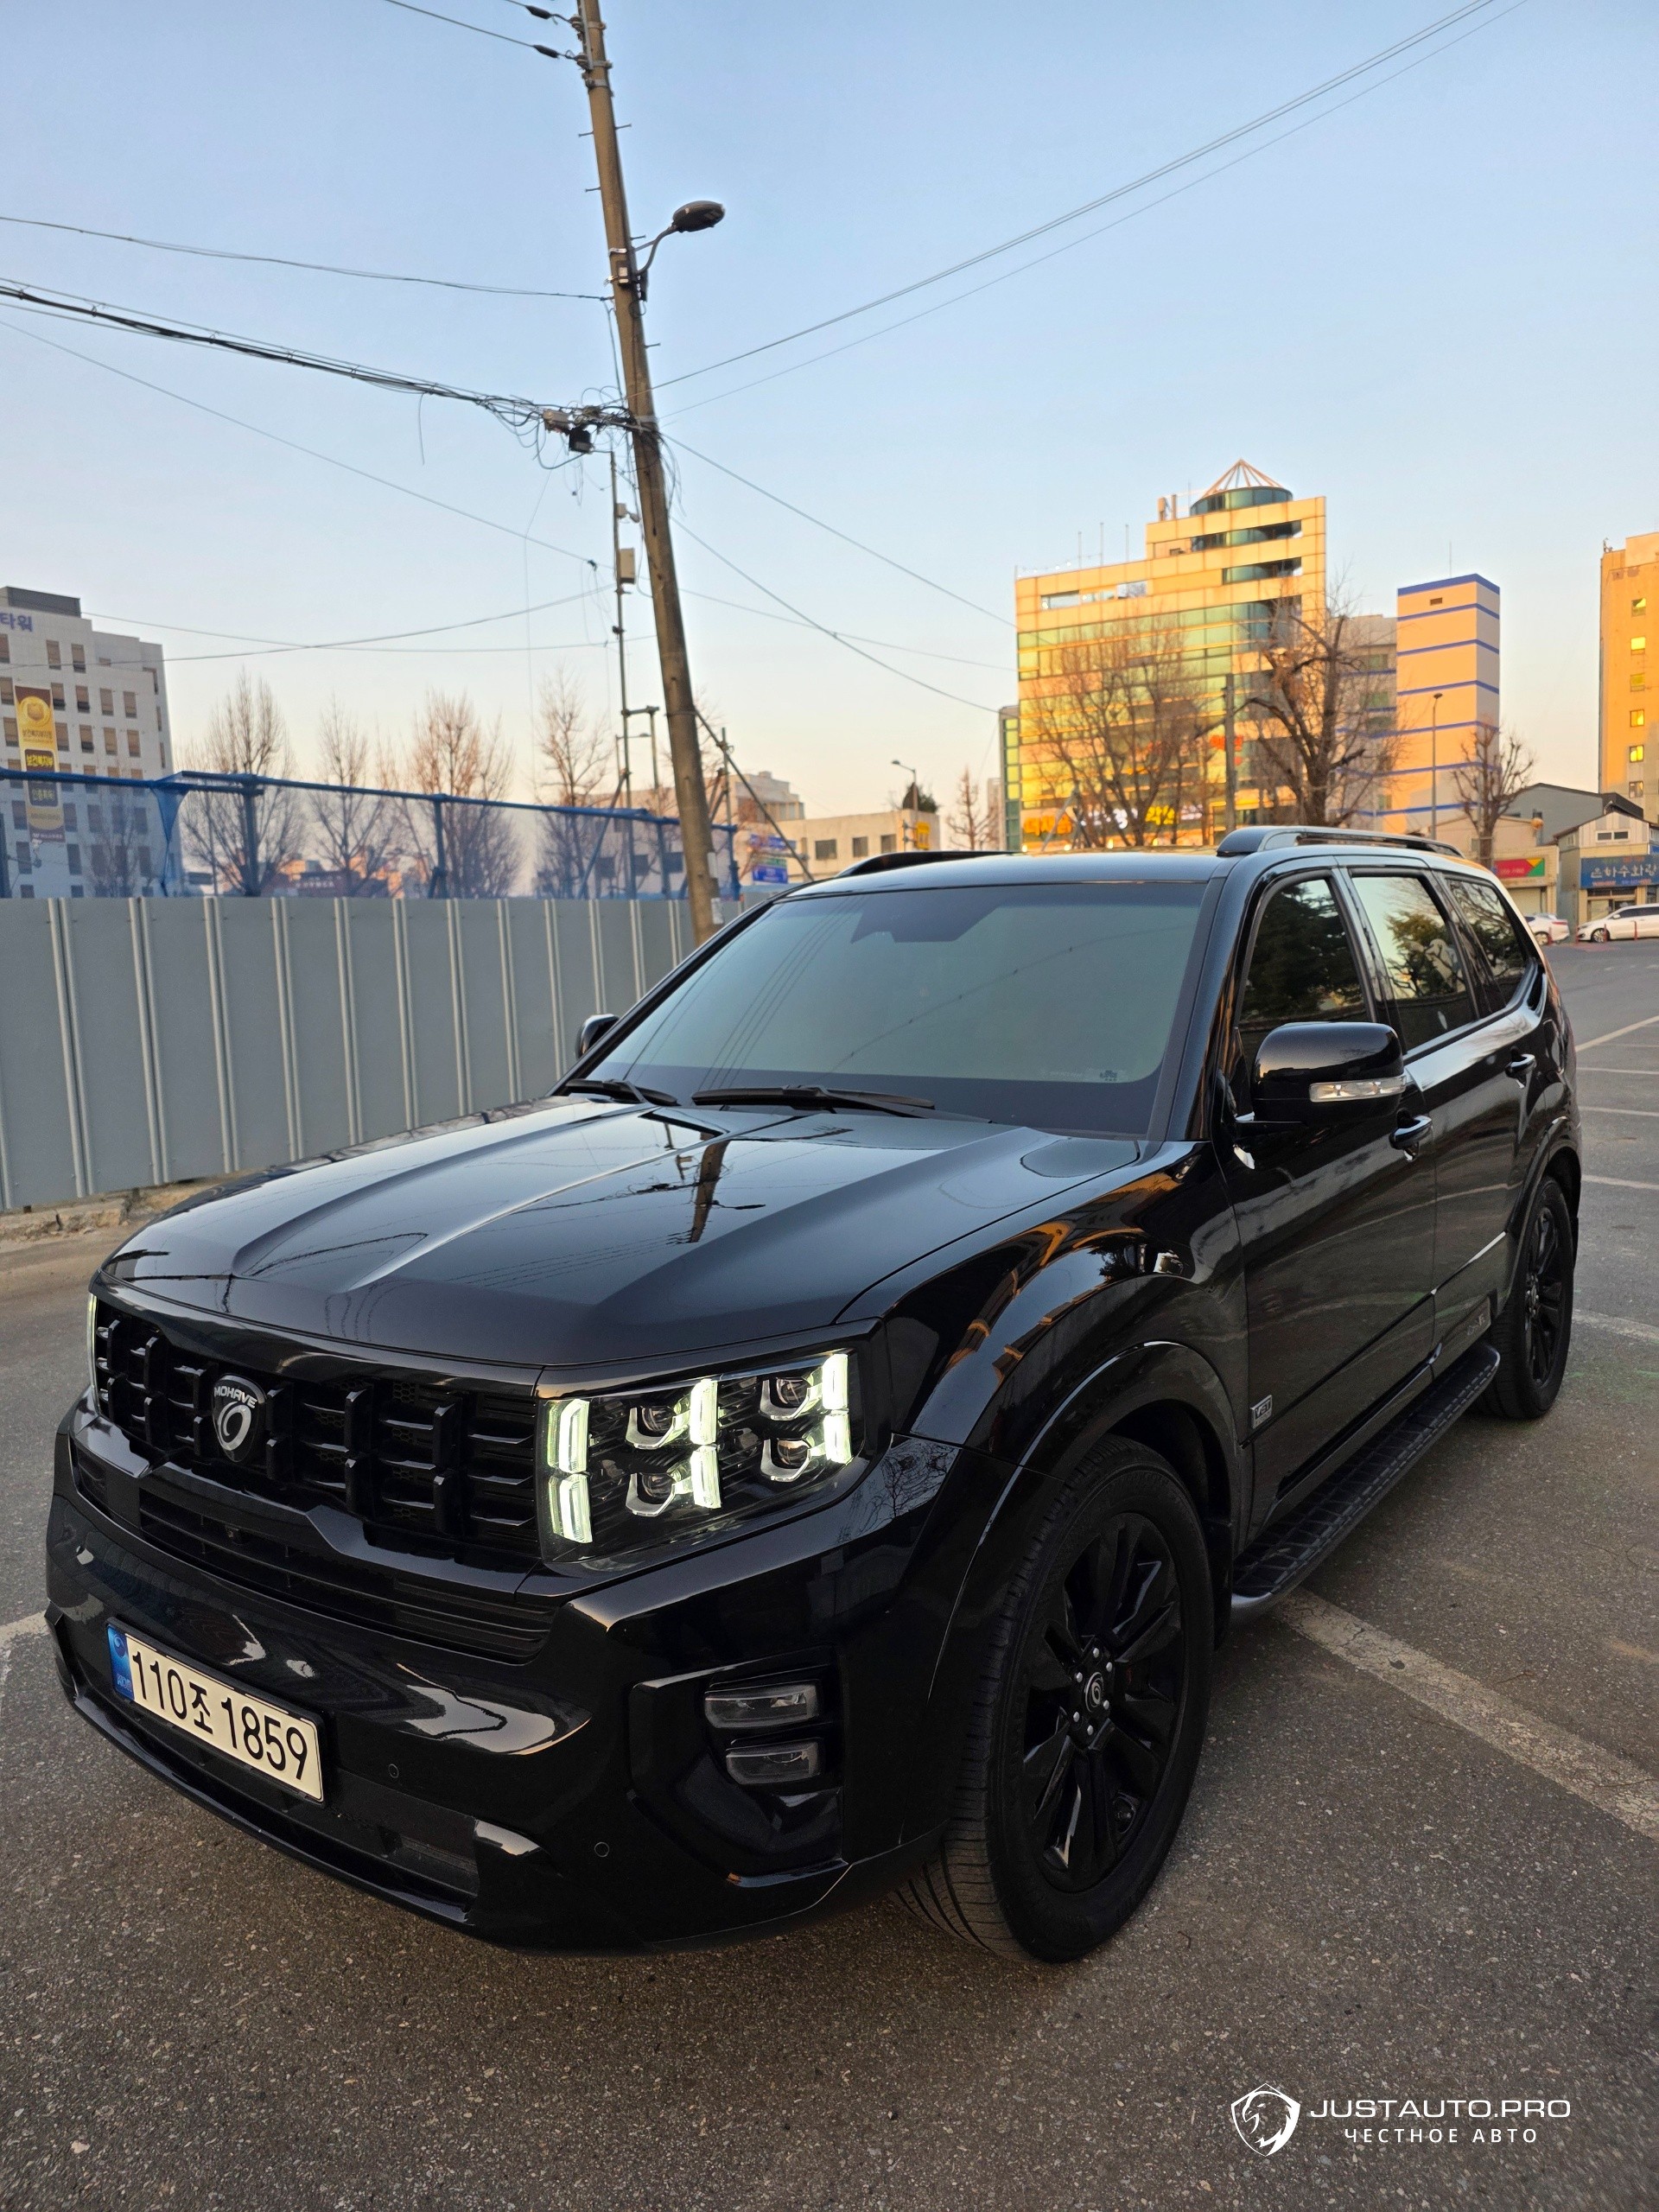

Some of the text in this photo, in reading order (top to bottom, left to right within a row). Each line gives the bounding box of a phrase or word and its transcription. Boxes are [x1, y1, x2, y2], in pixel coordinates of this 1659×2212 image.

[213, 1385, 258, 1409] MOHAVE
[132, 1651, 308, 1780] 110조 1859
